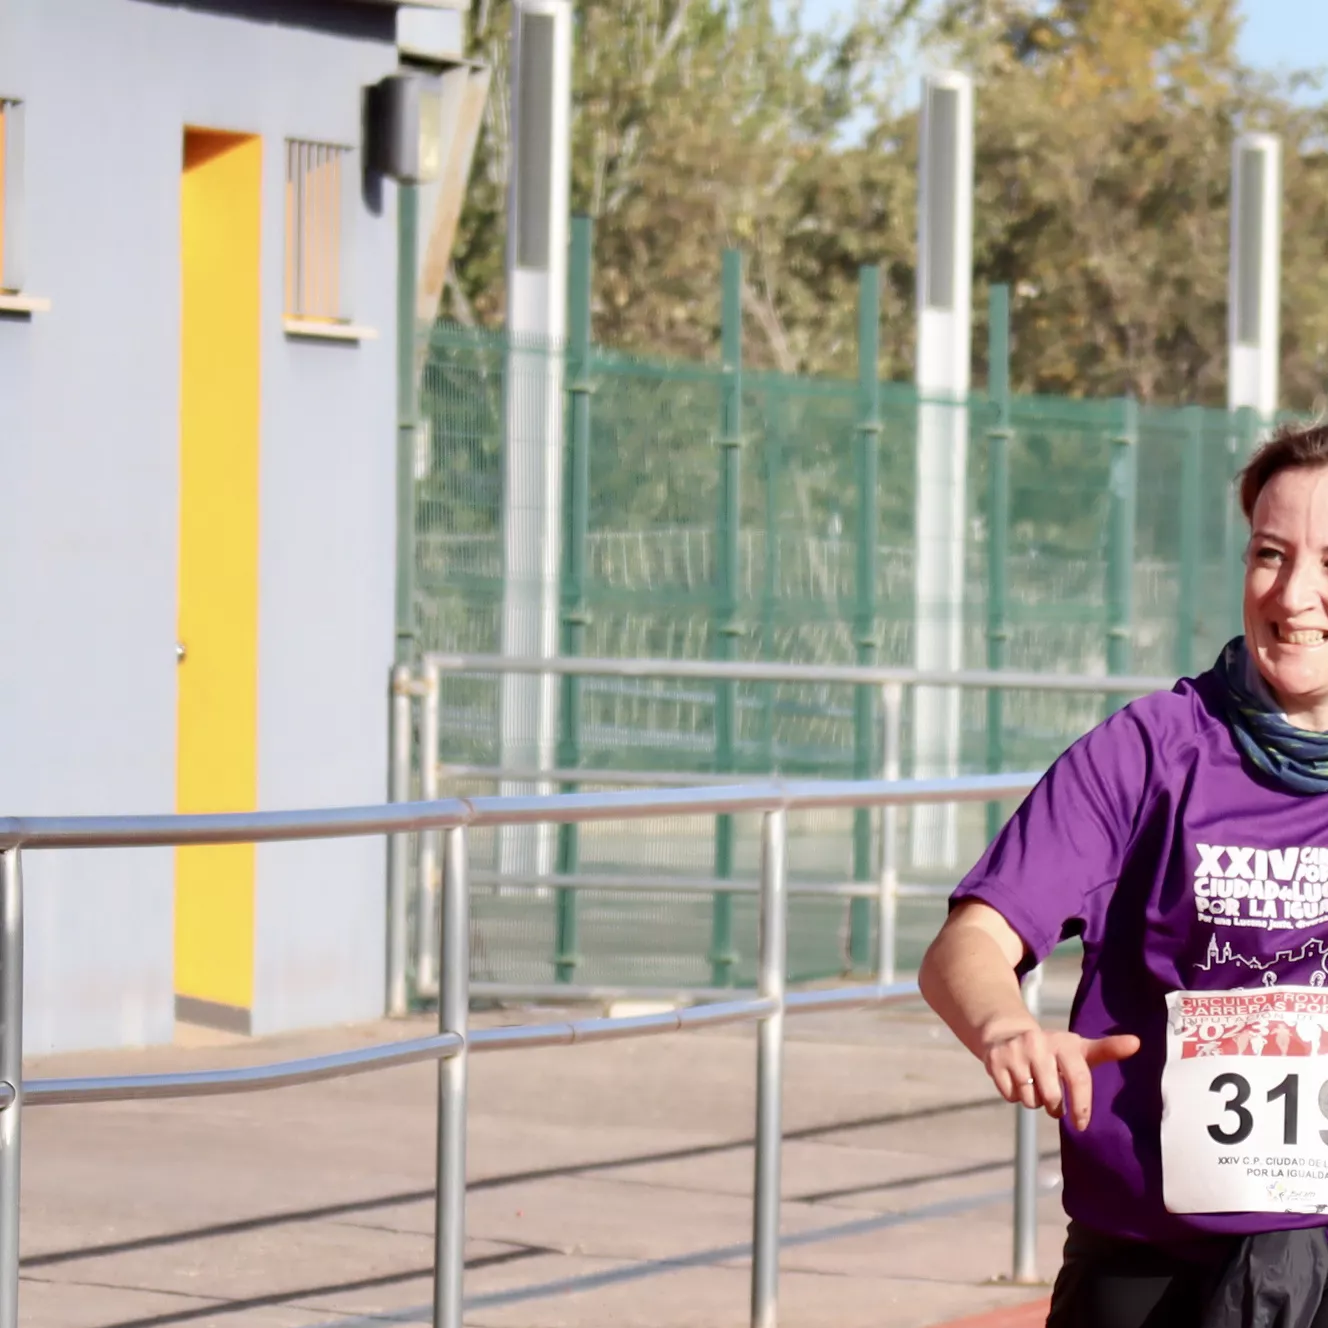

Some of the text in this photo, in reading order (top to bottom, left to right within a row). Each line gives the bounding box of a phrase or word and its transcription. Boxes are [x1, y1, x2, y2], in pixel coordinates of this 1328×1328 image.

[1194, 844, 1299, 881] XXIV
[1194, 877, 1280, 900] CIUDAD
[1195, 897, 1240, 916] POR
[1249, 900, 1277, 918] LA
[1181, 996, 1267, 1008] CIRCUITO
[1181, 1001, 1287, 1016] CARRERAS
[1181, 1018, 1269, 1041] 2023
[1217, 1156, 1240, 1166] XXIV
[1265, 1157, 1306, 1167] CIUDAD
[1308, 1158, 1321, 1168] DE
[1246, 1168, 1268, 1178] POR
[1271, 1168, 1284, 1178] LA
